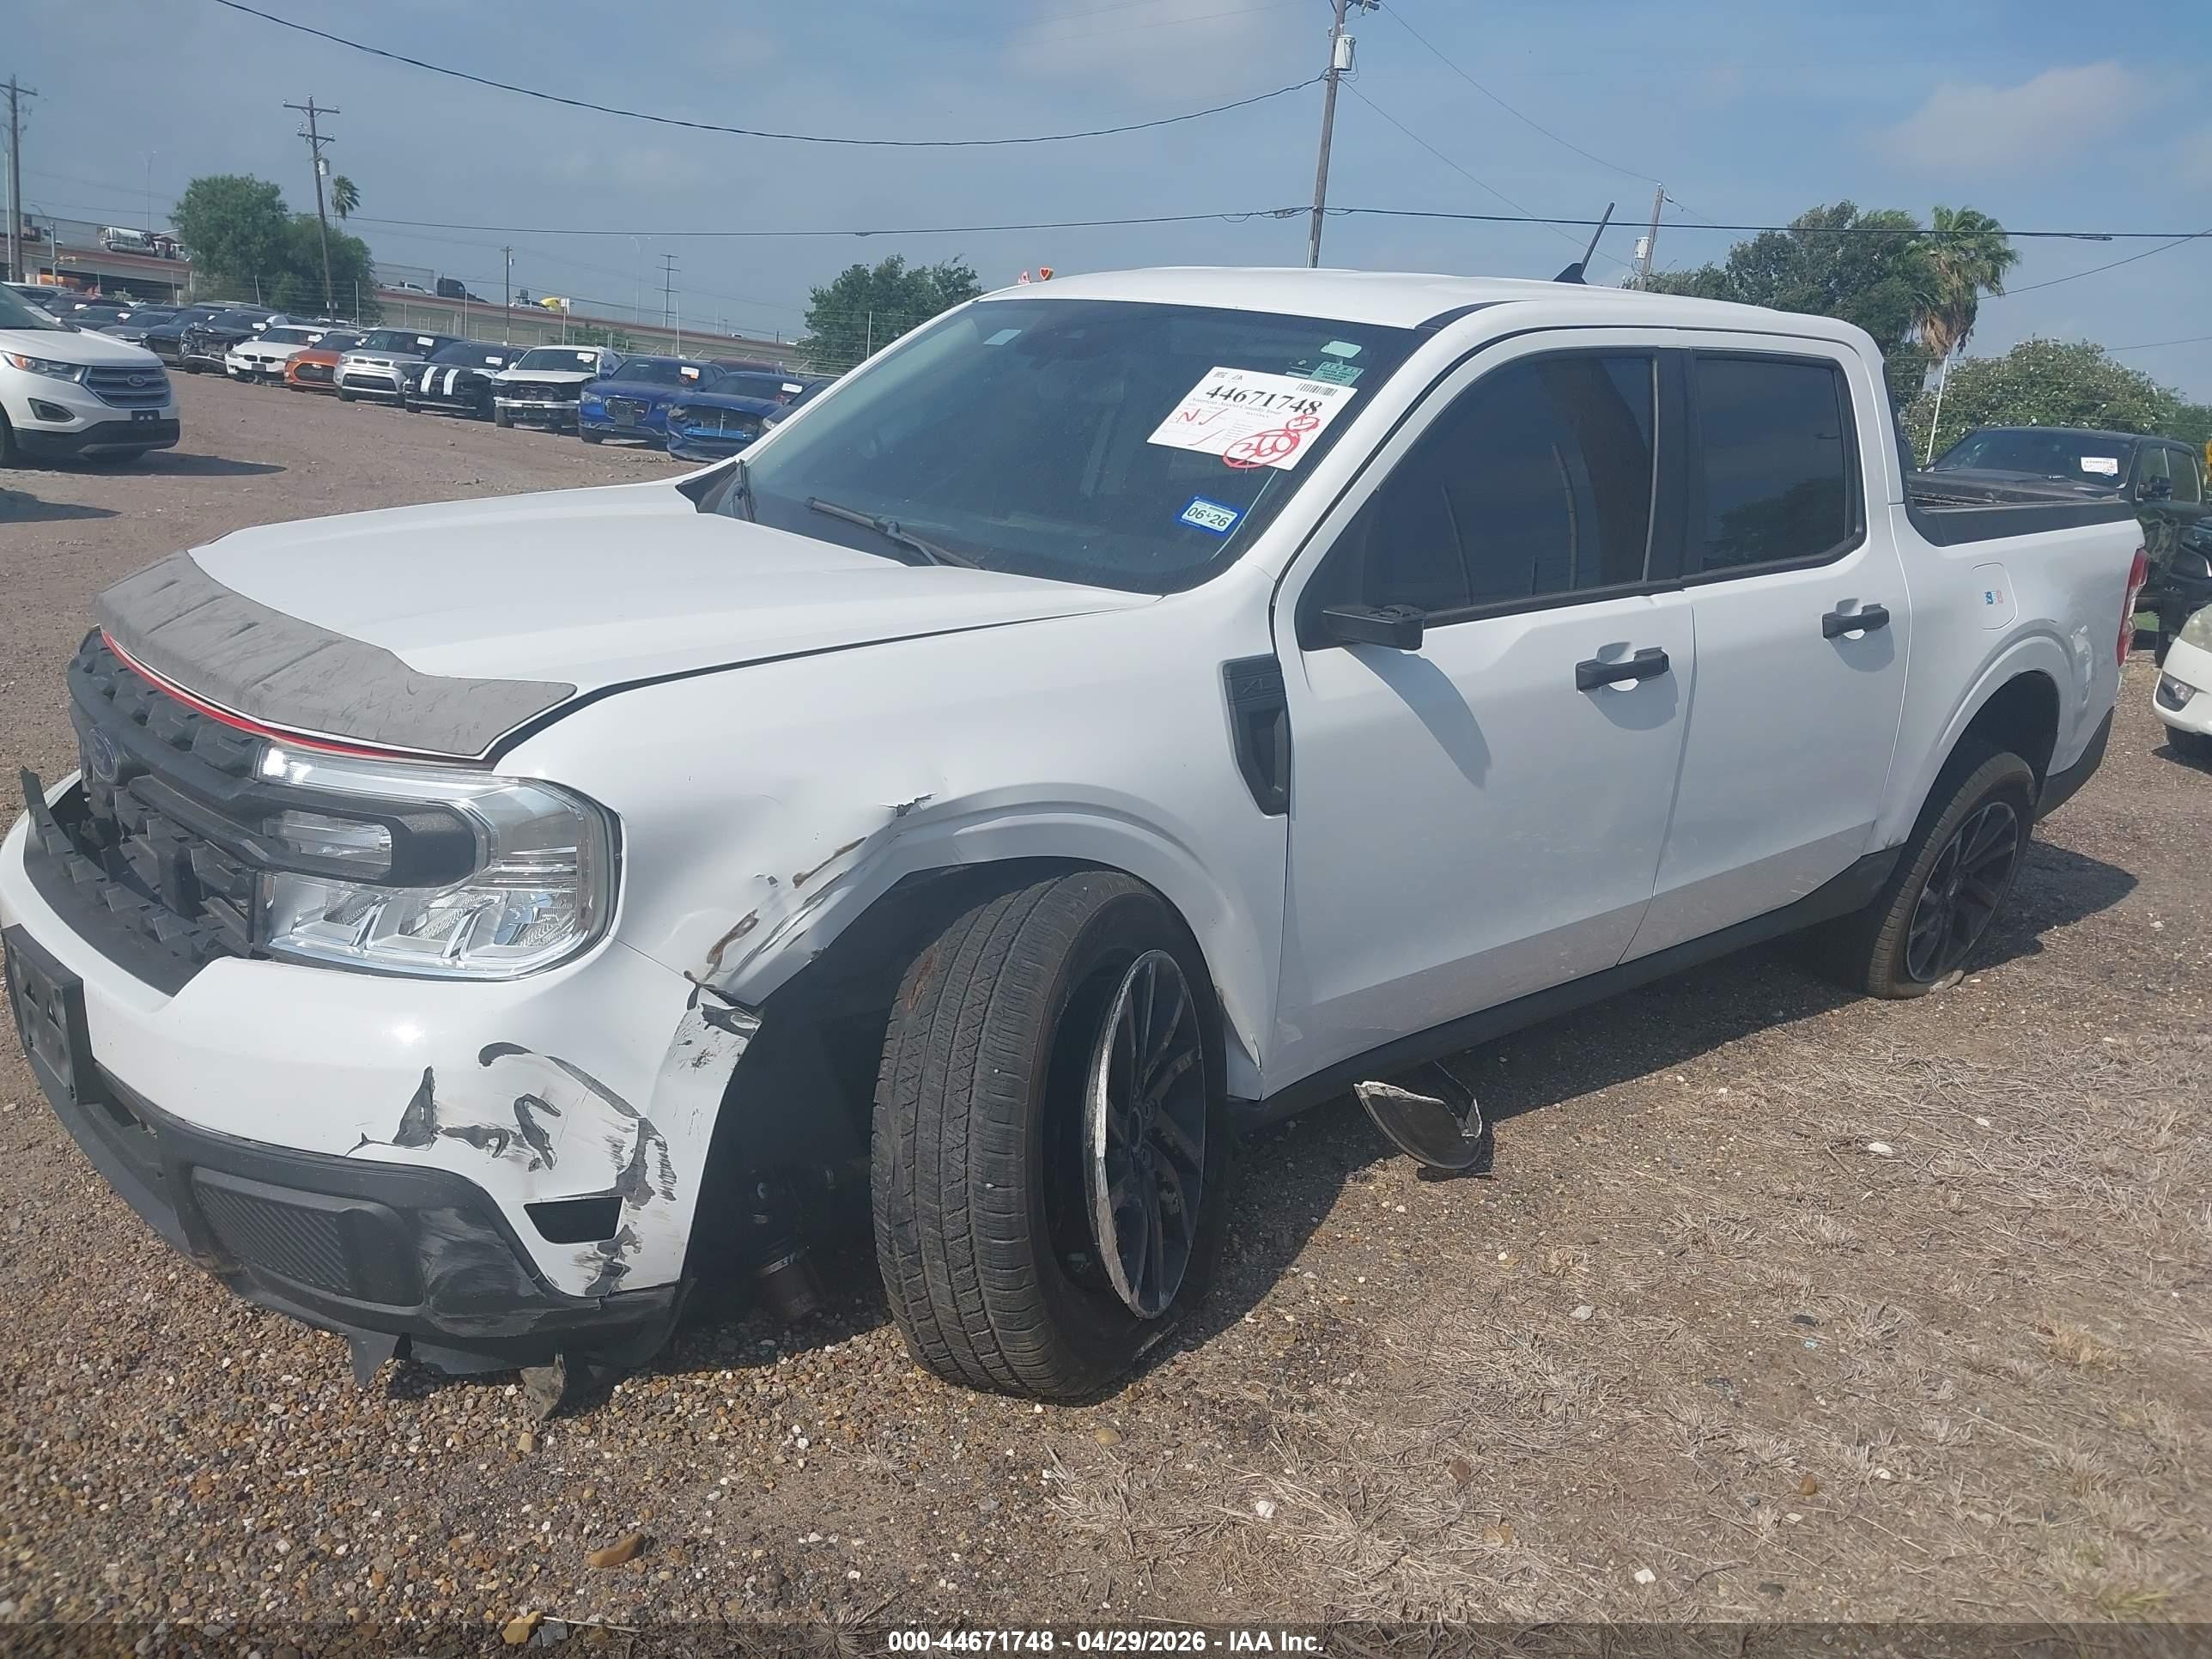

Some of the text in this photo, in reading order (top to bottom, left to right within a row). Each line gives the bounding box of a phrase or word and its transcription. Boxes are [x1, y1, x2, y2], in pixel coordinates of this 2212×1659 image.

[1205, 385, 1323, 416] 44671748
[1187, 507, 1230, 527] 06 26
[1243, 678, 1275, 695] XL
